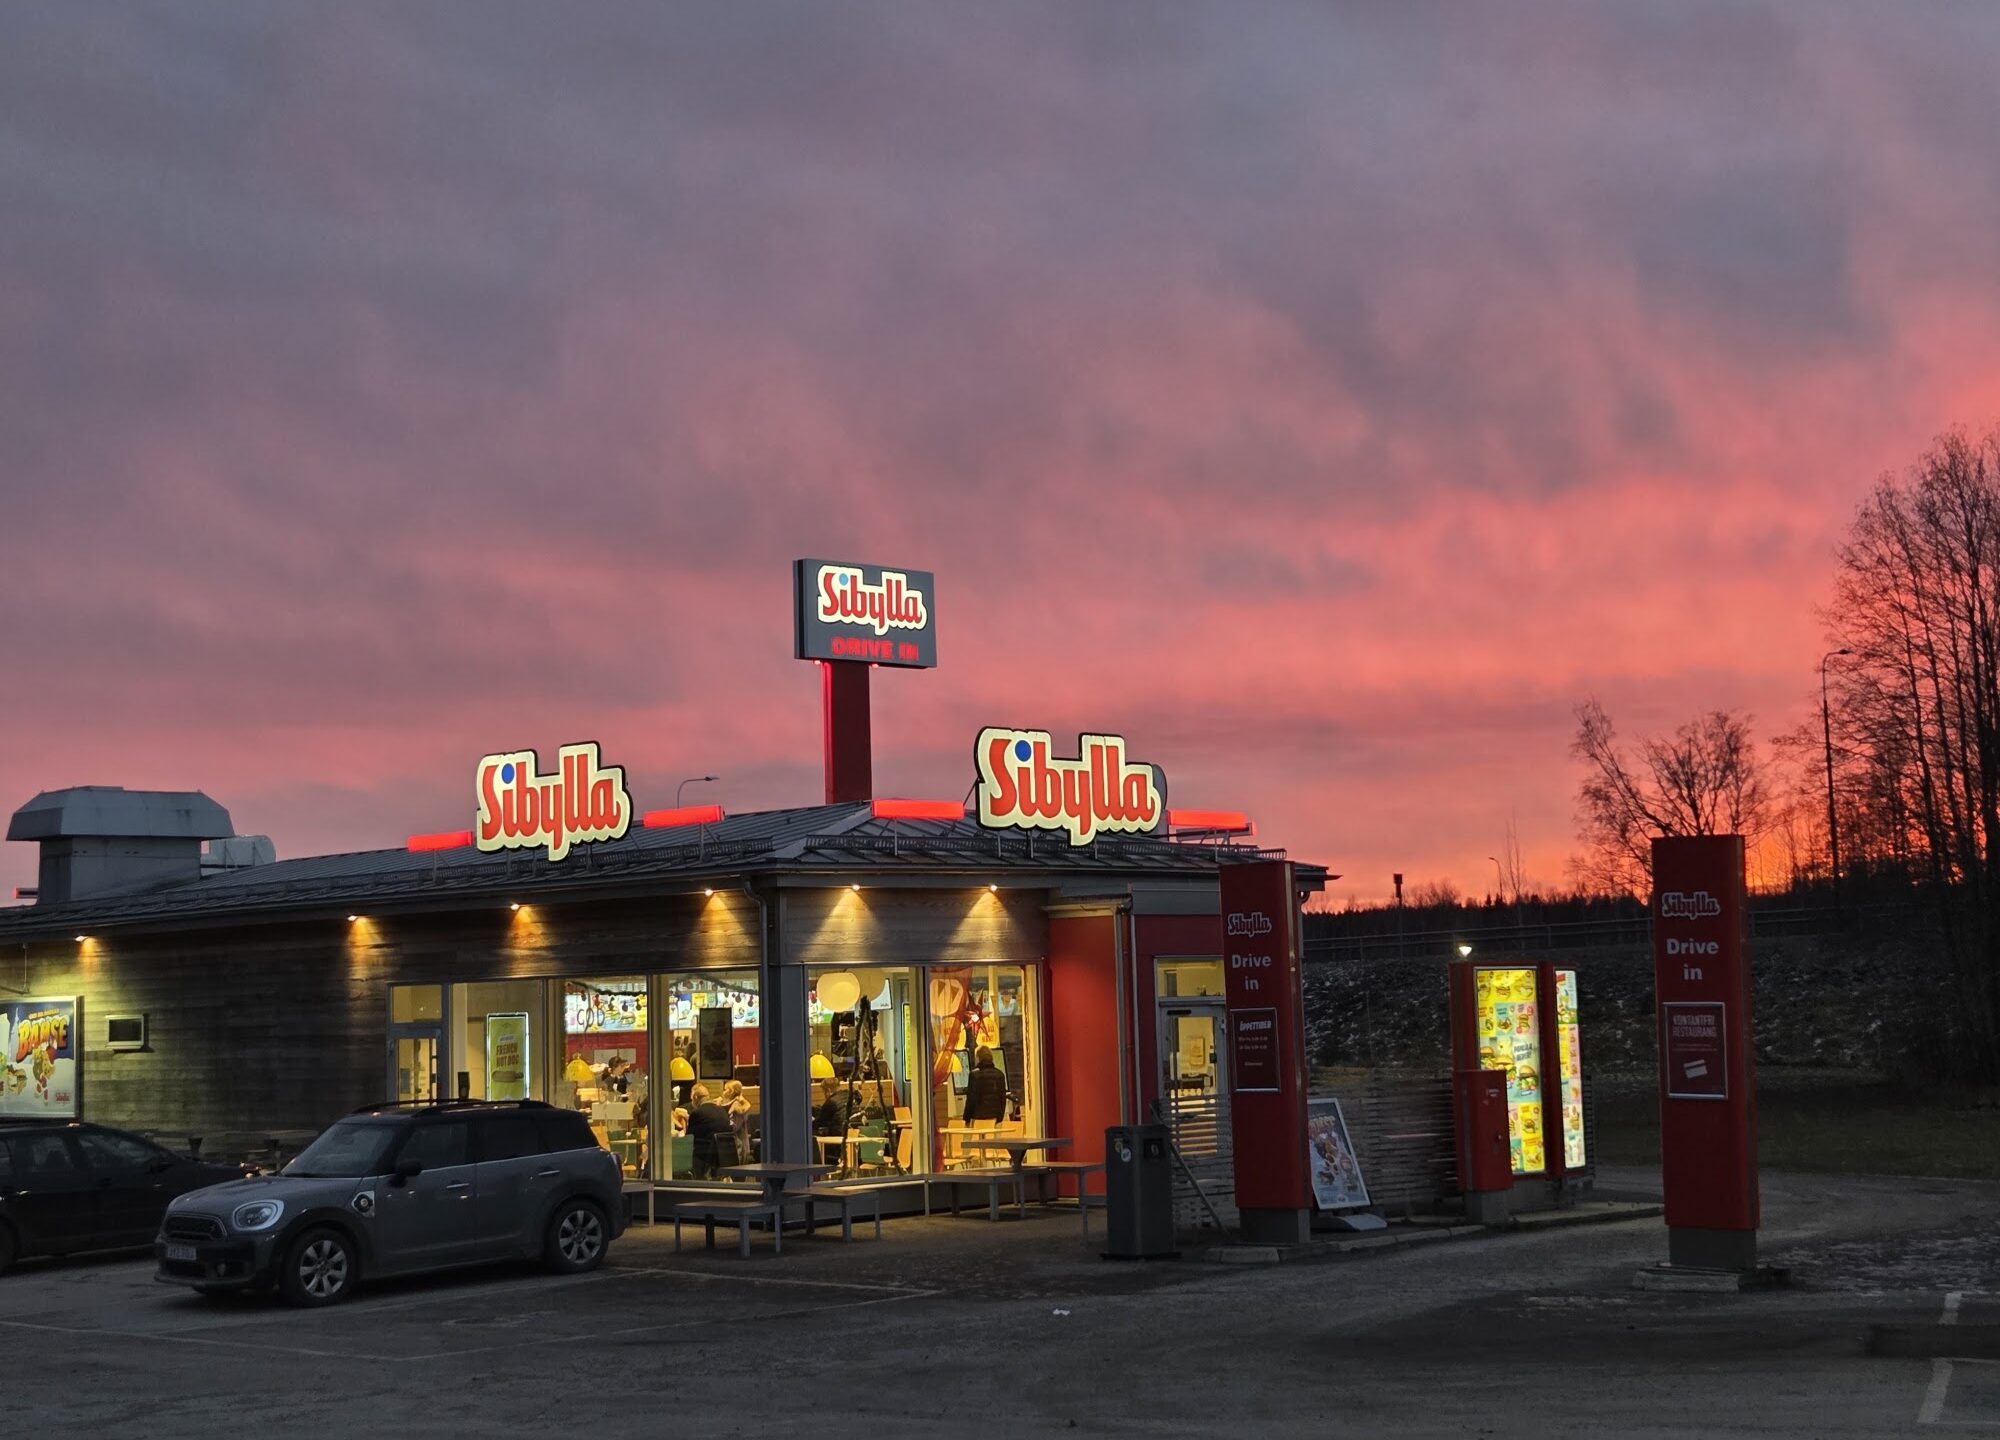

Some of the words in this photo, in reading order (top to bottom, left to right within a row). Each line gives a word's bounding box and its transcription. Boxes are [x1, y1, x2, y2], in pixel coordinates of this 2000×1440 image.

[822, 572, 924, 630] Sibylla
[831, 636, 894, 660] DRIVE
[900, 642, 919, 661] IN
[988, 737, 1156, 836] Sibylla
[481, 752, 622, 851] Sibylla
[1662, 891, 1720, 920] Sibylla
[1228, 912, 1272, 937] Sibylla
[1666, 938, 1719, 955] Drive
[1231, 953, 1272, 969] Drive
[1683, 963, 1703, 980] in
[1244, 975, 1259, 990] in
[16, 1016, 69, 1063] BAMSE
[1671, 1025, 1718, 1037] RESTAURANG
[496, 1042, 518, 1056] FRENCH
